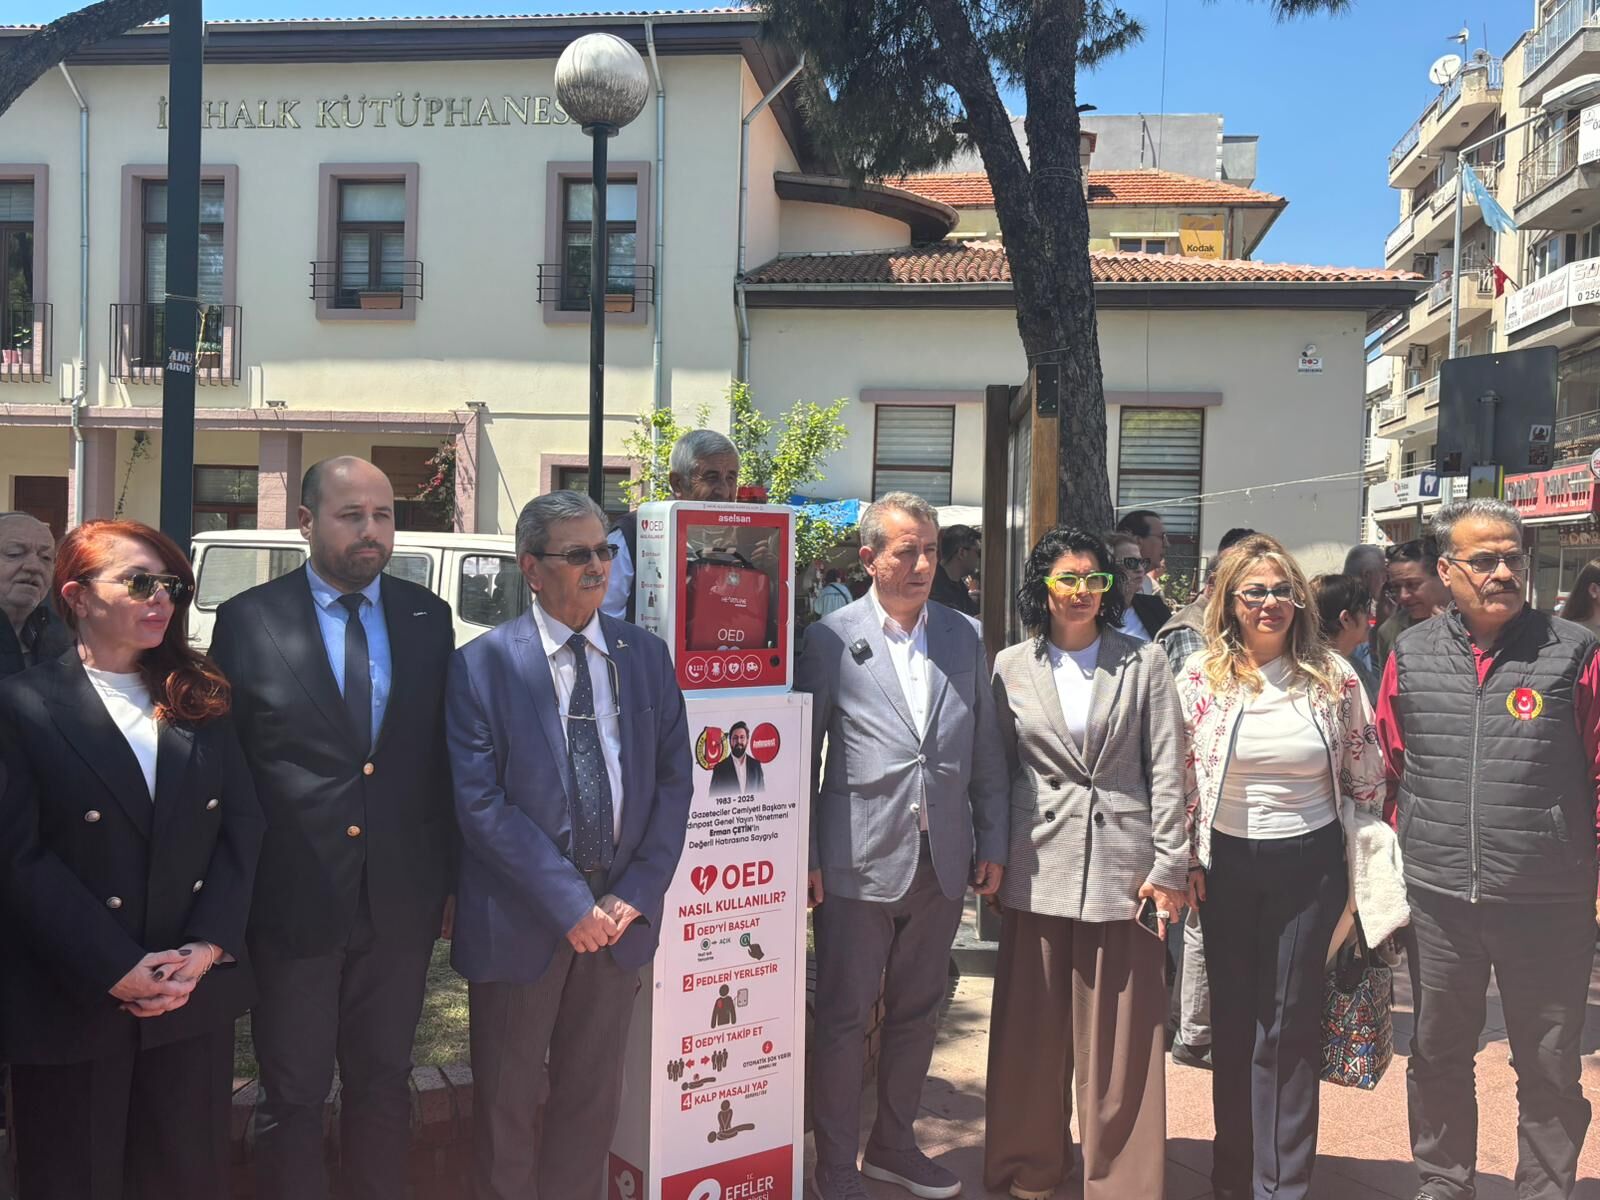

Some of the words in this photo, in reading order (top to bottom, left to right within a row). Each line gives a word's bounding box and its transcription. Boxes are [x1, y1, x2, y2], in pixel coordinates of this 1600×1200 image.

[202, 100, 301, 128] HALK
[316, 92, 578, 129] KÜTÜPHANES
[1186, 244, 1214, 252] Kodak
[718, 514, 751, 523] aselsan
[717, 628, 744, 642] OED
[716, 797, 731, 805] 1983
[738, 794, 755, 803] 2025
[691, 808, 730, 819] Gazeteciler
[732, 805, 761, 815] Cemiyeti
[762, 803, 787, 812] Başkanı
[686, 820, 713, 830] dınpost
[714, 817, 734, 826] Genel
[736, 816, 753, 824] Yayın
[755, 811, 788, 821] Yönetmeni
[689, 839, 714, 849] Değerli
[715, 836, 749, 846] Hatırasına
[750, 832, 778, 842] Saygıyla
[722, 860, 774, 890] OED
[678, 903, 712, 918] NASIL
[716, 891, 786, 912] KULLANILIR?
[697, 923, 727, 936] OED'Yİ
[729, 918, 760, 931] BAŞLAT
[696, 972, 732, 987] PEDLERİ
[734, 964, 778, 979] YERLEŞTİR
[695, 1032, 724, 1048] OED'Yİ
[727, 1028, 751, 1041] TAKİP
[753, 1026, 763, 1036] ET
[743, 1058, 766, 1068] OTOMATİK
[694, 1092, 717, 1105] KALP
[718, 1084, 749, 1100] MASAJI
[752, 1080, 768, 1092] YAP
[725, 1176, 774, 1200] EFELER
